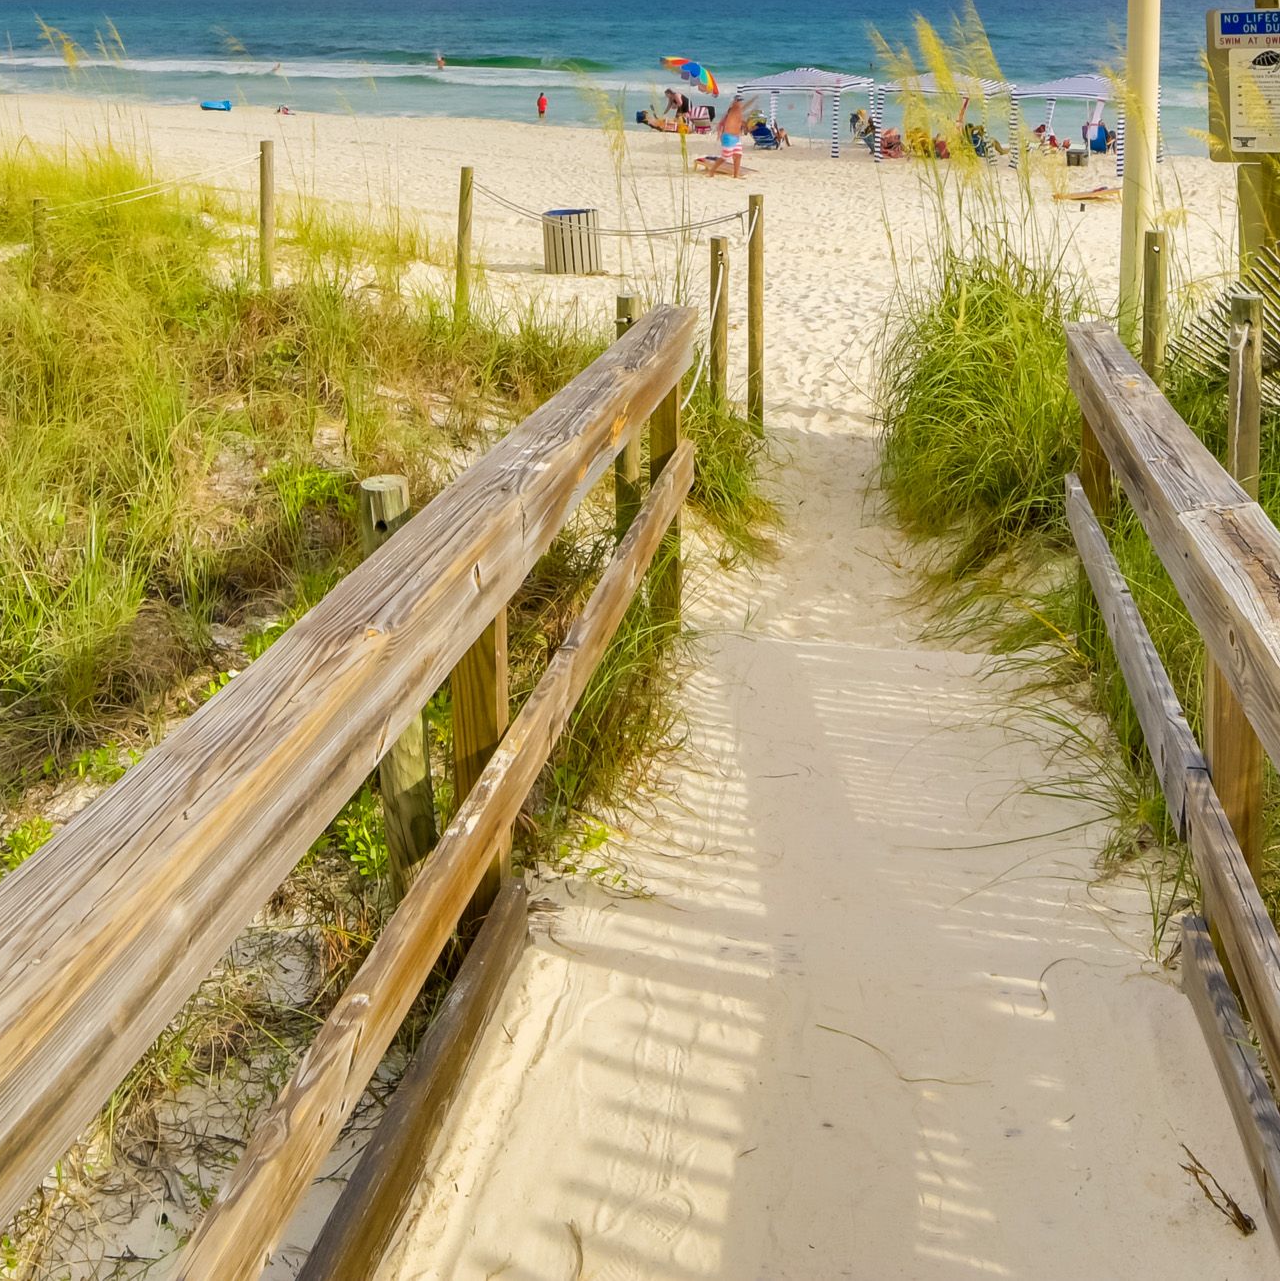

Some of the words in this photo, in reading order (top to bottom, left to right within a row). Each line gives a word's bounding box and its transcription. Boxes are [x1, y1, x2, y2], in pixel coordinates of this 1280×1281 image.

[1224, 14, 1239, 23] NO
[1243, 24, 1257, 33] ON
[1220, 37, 1240, 45] SWIM
